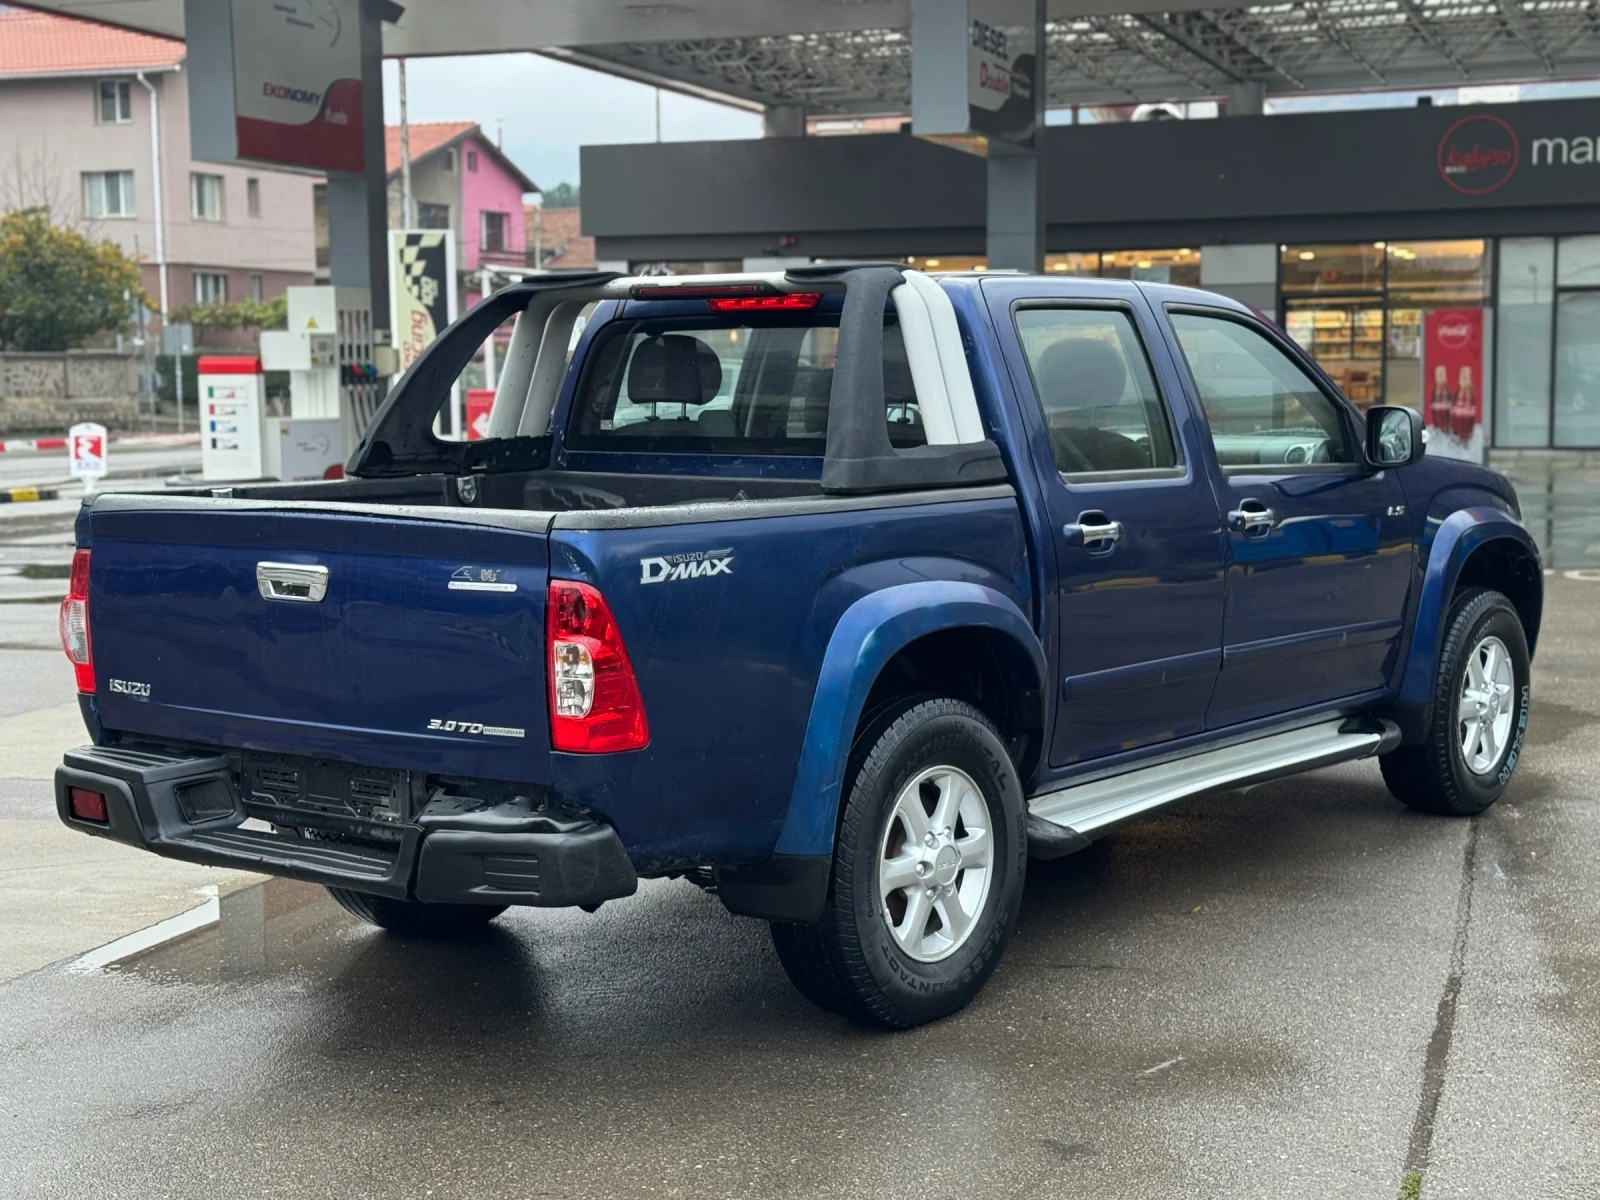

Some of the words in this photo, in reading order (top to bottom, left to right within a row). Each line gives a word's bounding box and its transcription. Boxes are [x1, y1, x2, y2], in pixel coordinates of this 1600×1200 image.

[973, 19, 1008, 61] DIESEL
[263, 82, 321, 106] EKONOMY
[1387, 505, 1404, 516] LS
[640, 557, 734, 584] D-MAX
[110, 679, 150, 696] ISUZU
[1499, 684, 1529, 786] NEXEN
